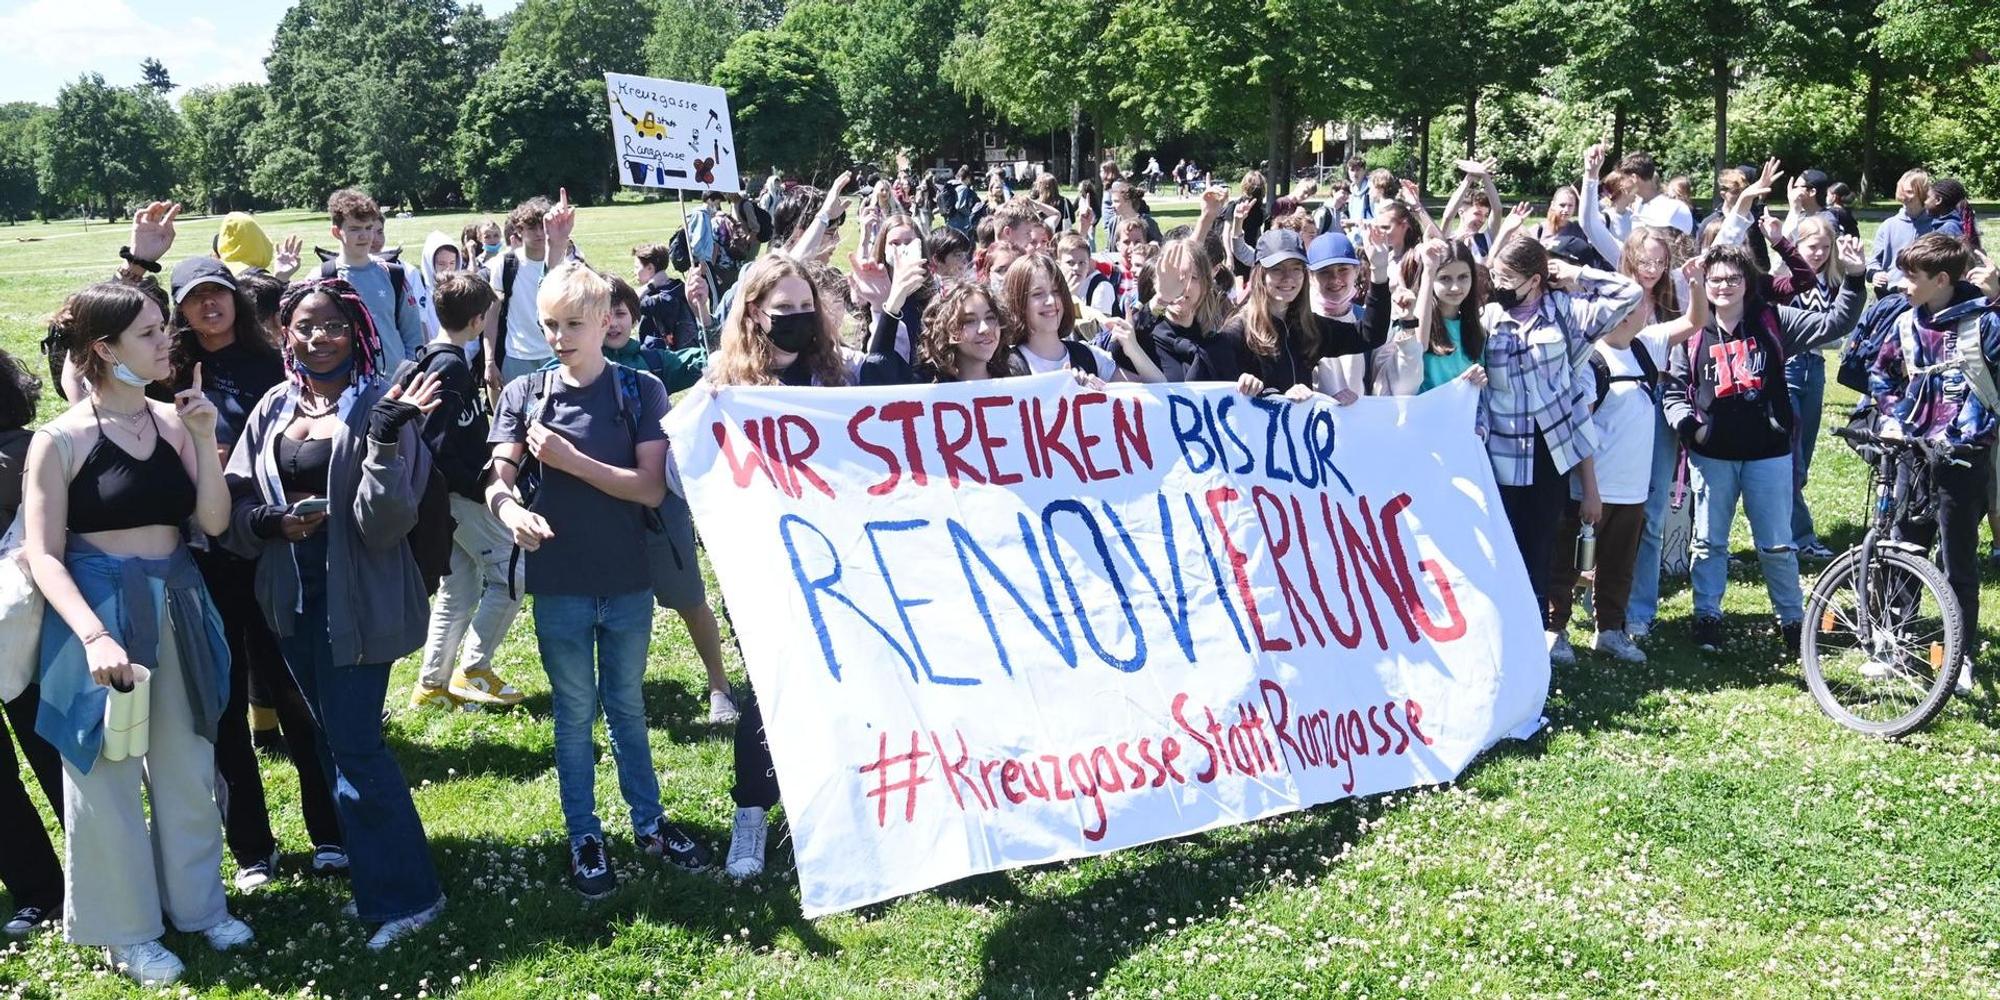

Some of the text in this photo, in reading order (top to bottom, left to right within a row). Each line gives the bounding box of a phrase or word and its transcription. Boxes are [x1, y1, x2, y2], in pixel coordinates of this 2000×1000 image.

[617, 80, 699, 112] Kreuzgasse
[711, 392, 1355, 500] WIR STREIKEN BIS ZUR
[779, 485, 1467, 686] RENOVIERUNG
[858, 679, 1434, 842] #KreuzgasseStattRanzgasse
